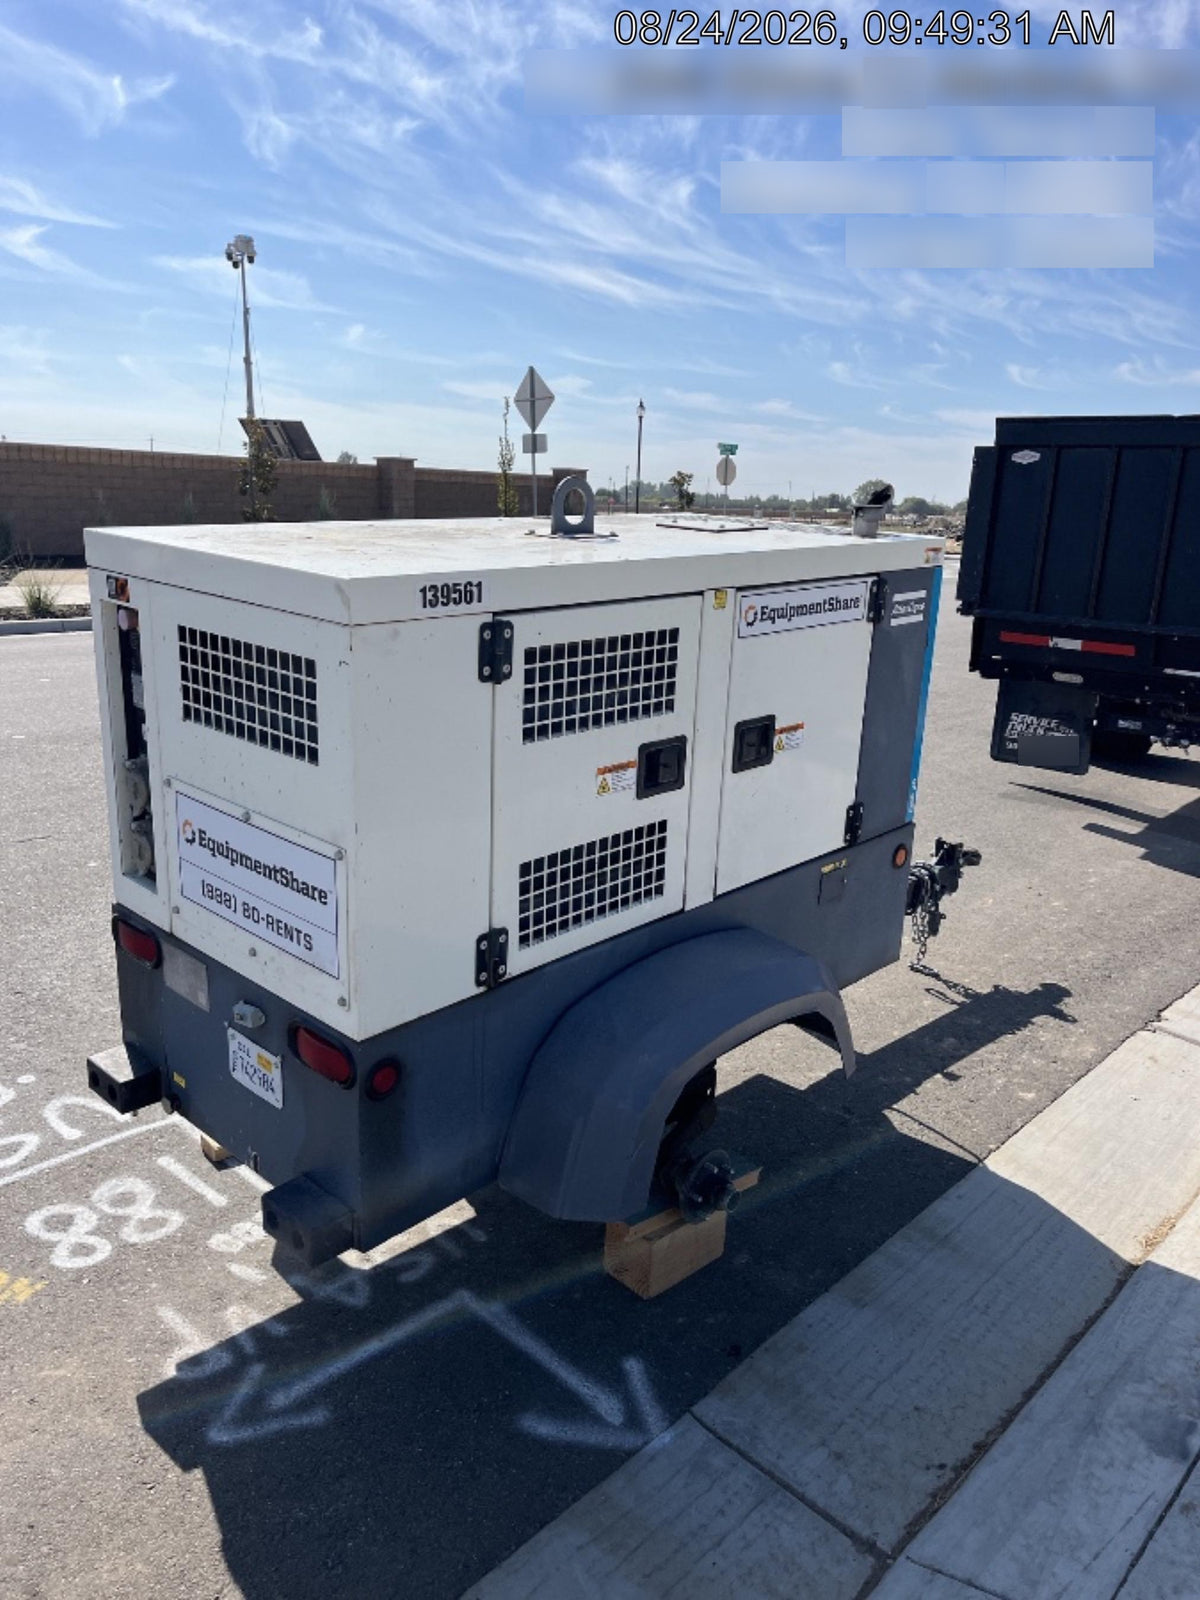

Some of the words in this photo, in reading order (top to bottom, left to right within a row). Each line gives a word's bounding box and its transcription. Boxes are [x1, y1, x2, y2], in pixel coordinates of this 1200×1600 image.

[419, 580, 483, 609] 139561
[759, 596, 860, 625] EquipmentShare
[197, 827, 328, 906] EquipmentShare
